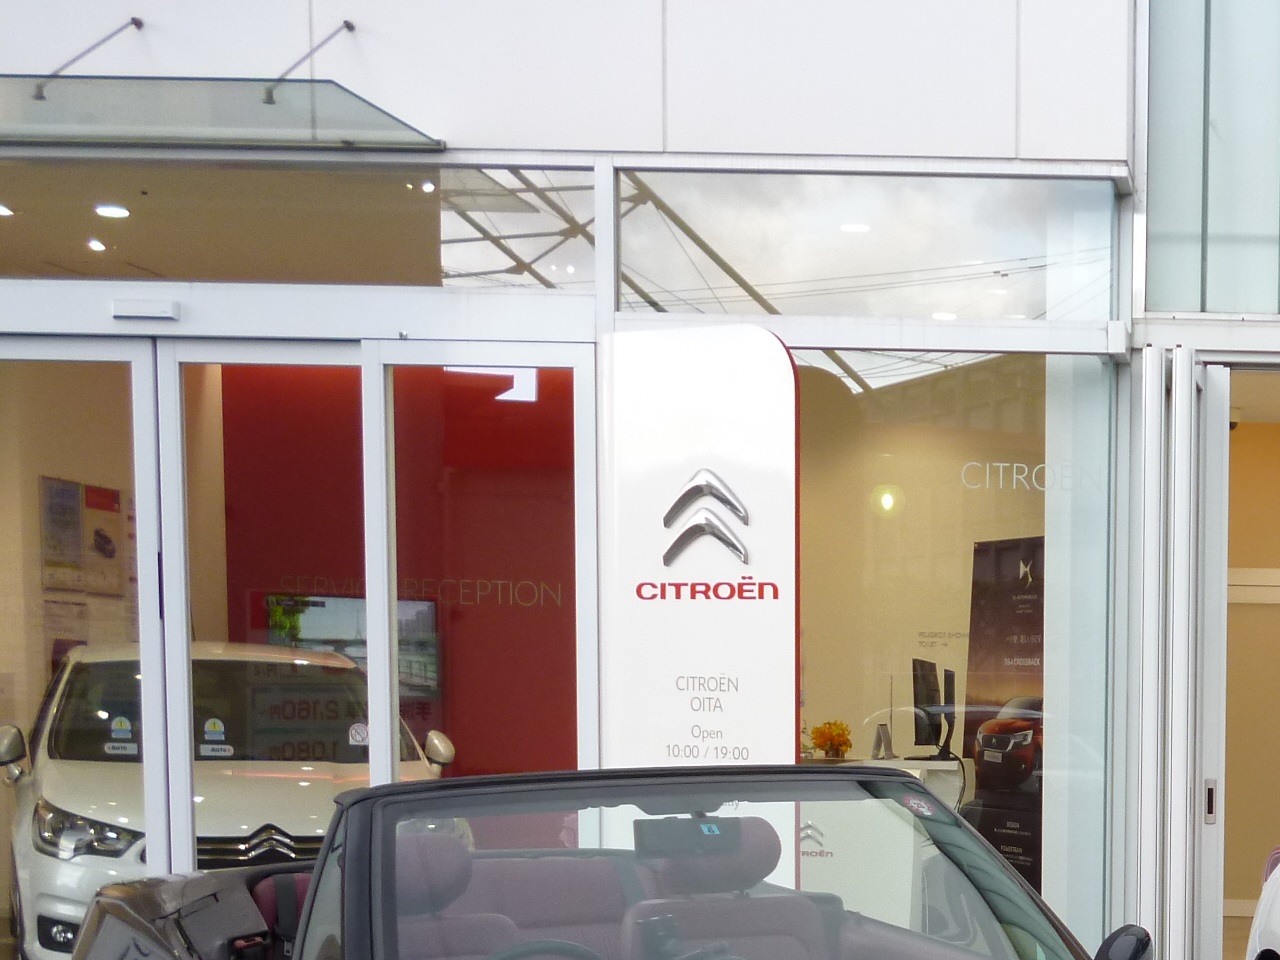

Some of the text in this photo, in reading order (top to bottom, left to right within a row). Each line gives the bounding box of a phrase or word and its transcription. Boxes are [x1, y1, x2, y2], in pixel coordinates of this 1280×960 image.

[280, 575, 562, 608] SERVIC RECEPTION
[676, 672, 740, 693] CITROËN
[690, 697, 724, 713] OITA
[691, 724, 723, 743] Open
[666, 744, 700, 759] 10:00
[713, 746, 749, 761] 19:00
